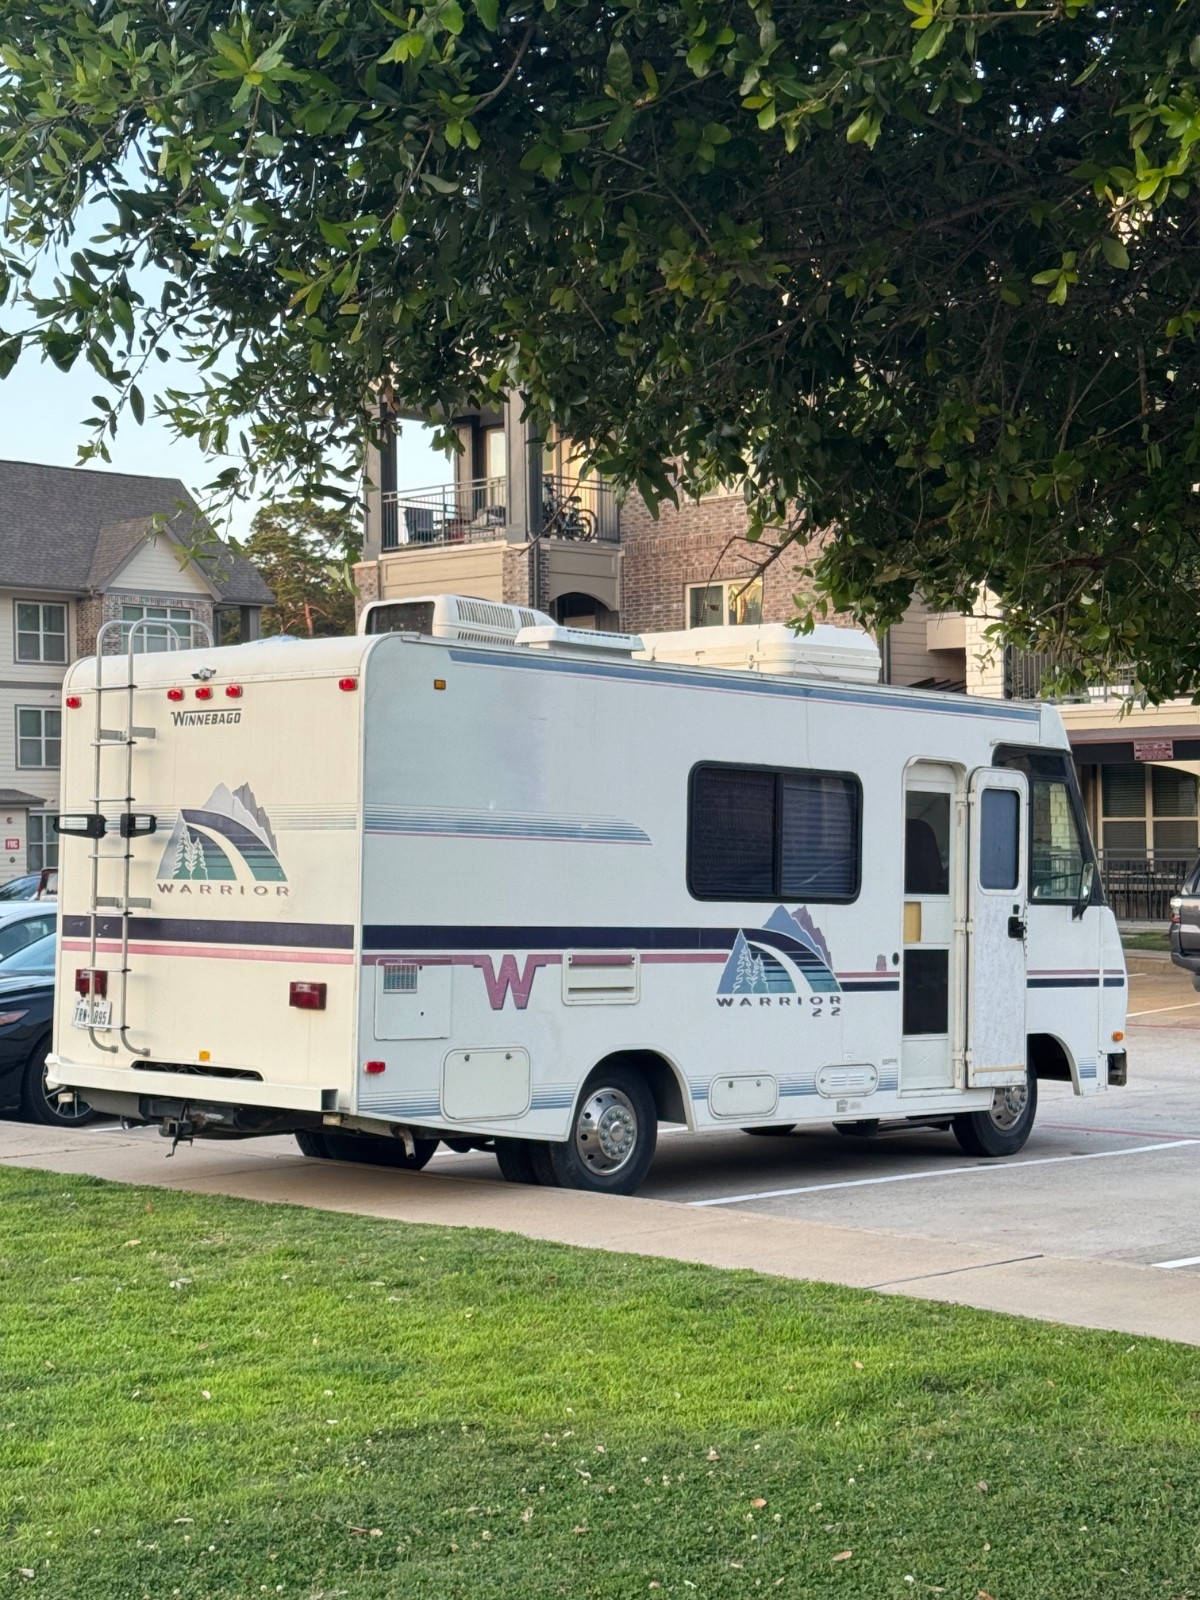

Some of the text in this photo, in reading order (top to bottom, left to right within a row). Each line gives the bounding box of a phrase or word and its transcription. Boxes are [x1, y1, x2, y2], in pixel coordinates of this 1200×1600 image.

[170, 708, 242, 727] WINNEBAGO
[7, 840, 18, 848] FDC
[157, 883, 290, 897] WARRIOR
[473, 954, 546, 1011] W
[716, 995, 842, 1007] WARRIOR
